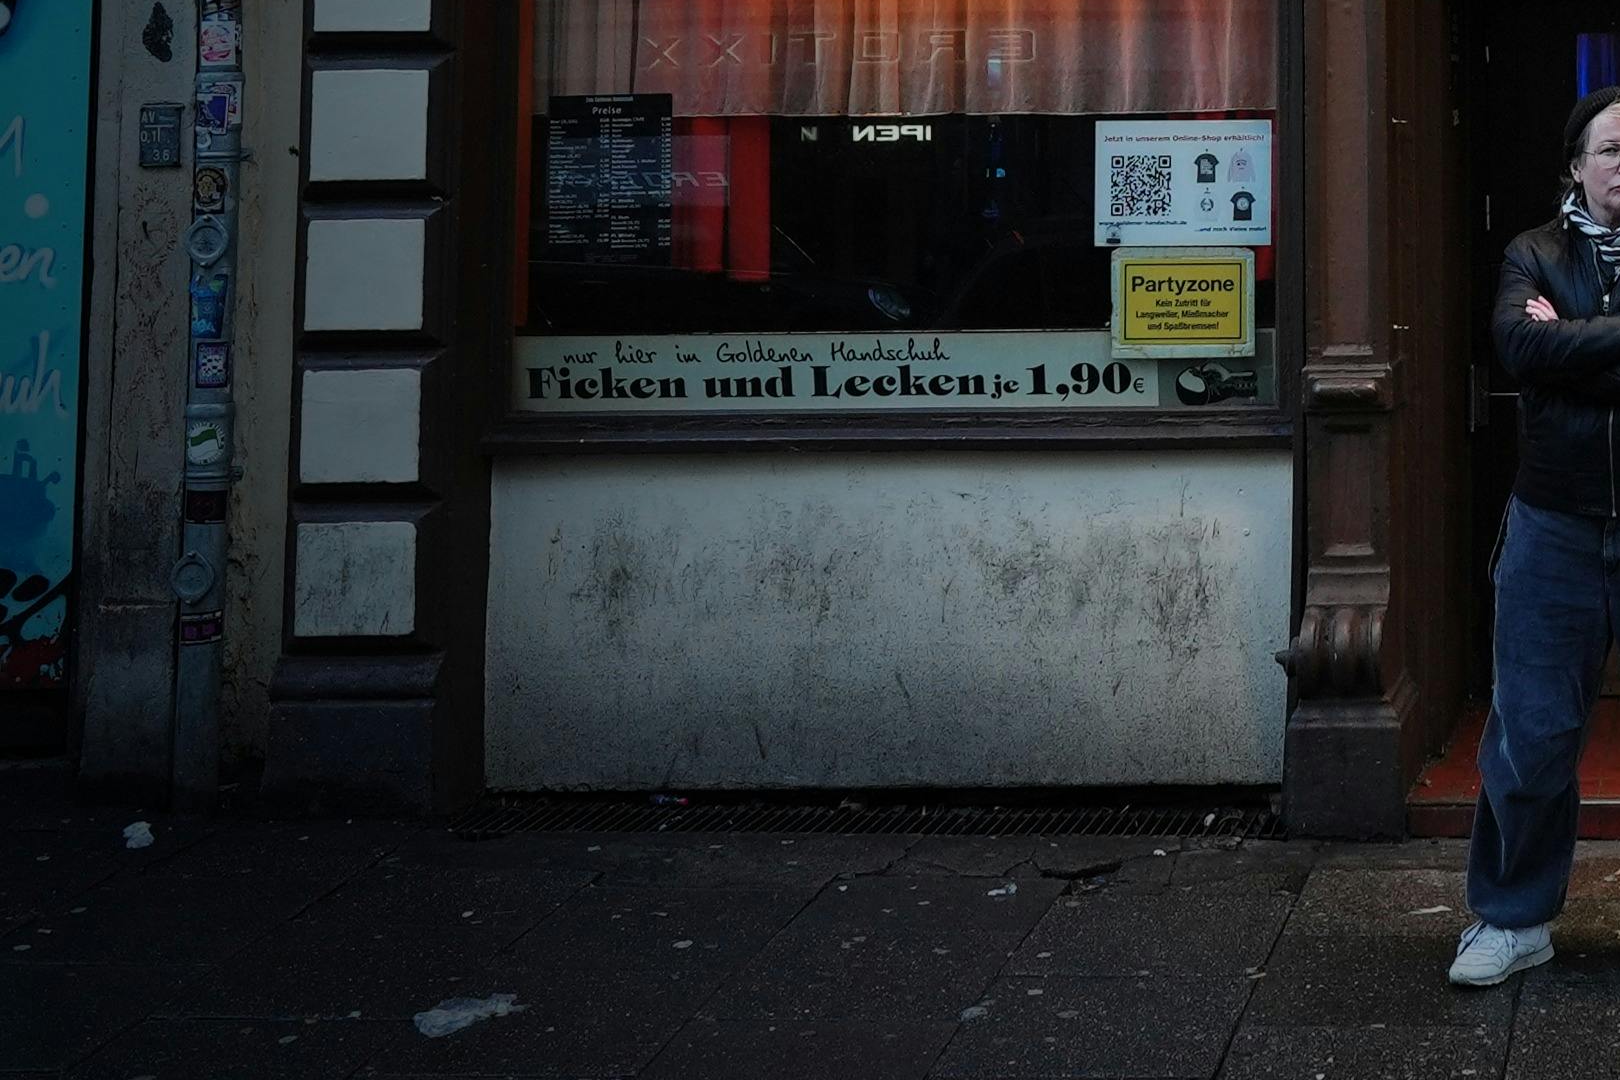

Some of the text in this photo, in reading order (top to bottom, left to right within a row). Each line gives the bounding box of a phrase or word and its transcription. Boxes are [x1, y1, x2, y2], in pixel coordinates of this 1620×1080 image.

[1131, 275, 1235, 295] Partyzone
[1155, 298, 1211, 307] Kein Zutritt für
[1135, 310, 1180, 320] Langweiler,
[1147, 322, 1162, 330] und
[563, 337, 951, 365] nur hier im Goldenen Handschuh
[525, 366, 689, 400] Ficken
[702, 365, 797, 399] und
[810, 363, 988, 400] Lecken
[991, 374, 1019, 400] je
